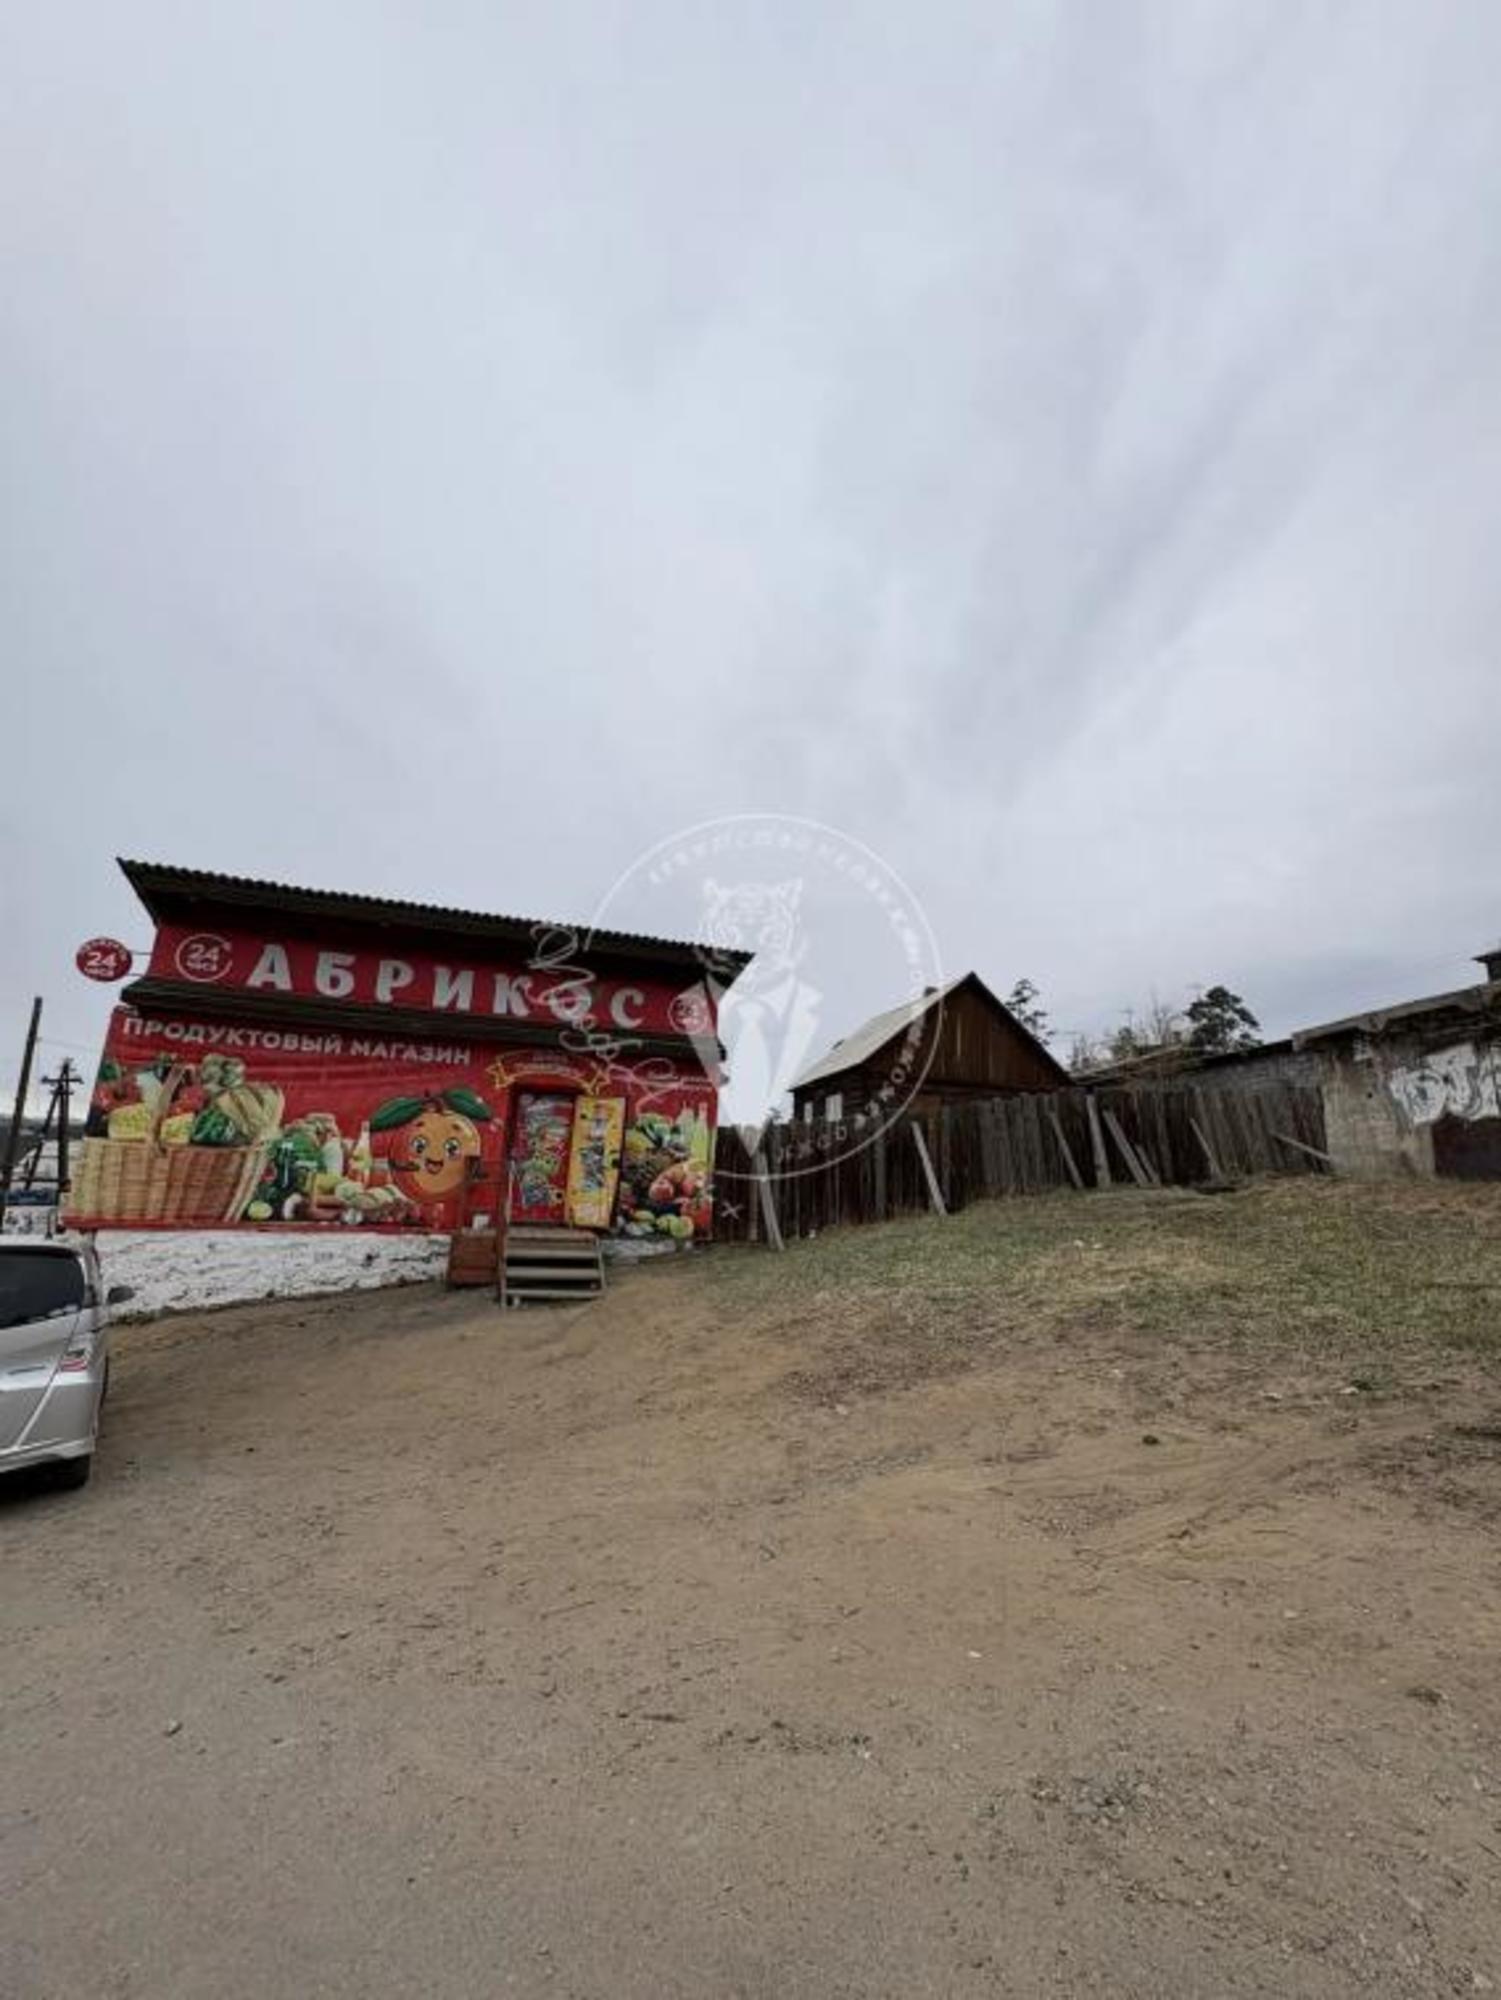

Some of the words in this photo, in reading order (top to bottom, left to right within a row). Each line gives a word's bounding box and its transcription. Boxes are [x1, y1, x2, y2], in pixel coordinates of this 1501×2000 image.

[86, 951, 114, 966] 24
[187, 942, 219, 962] 24
[246, 943, 645, 1029] АБРИКОС
[121, 1016, 342, 1055] ПРОДУКТОВЫЙ
[350, 1038, 471, 1065] МАГАЗИН
